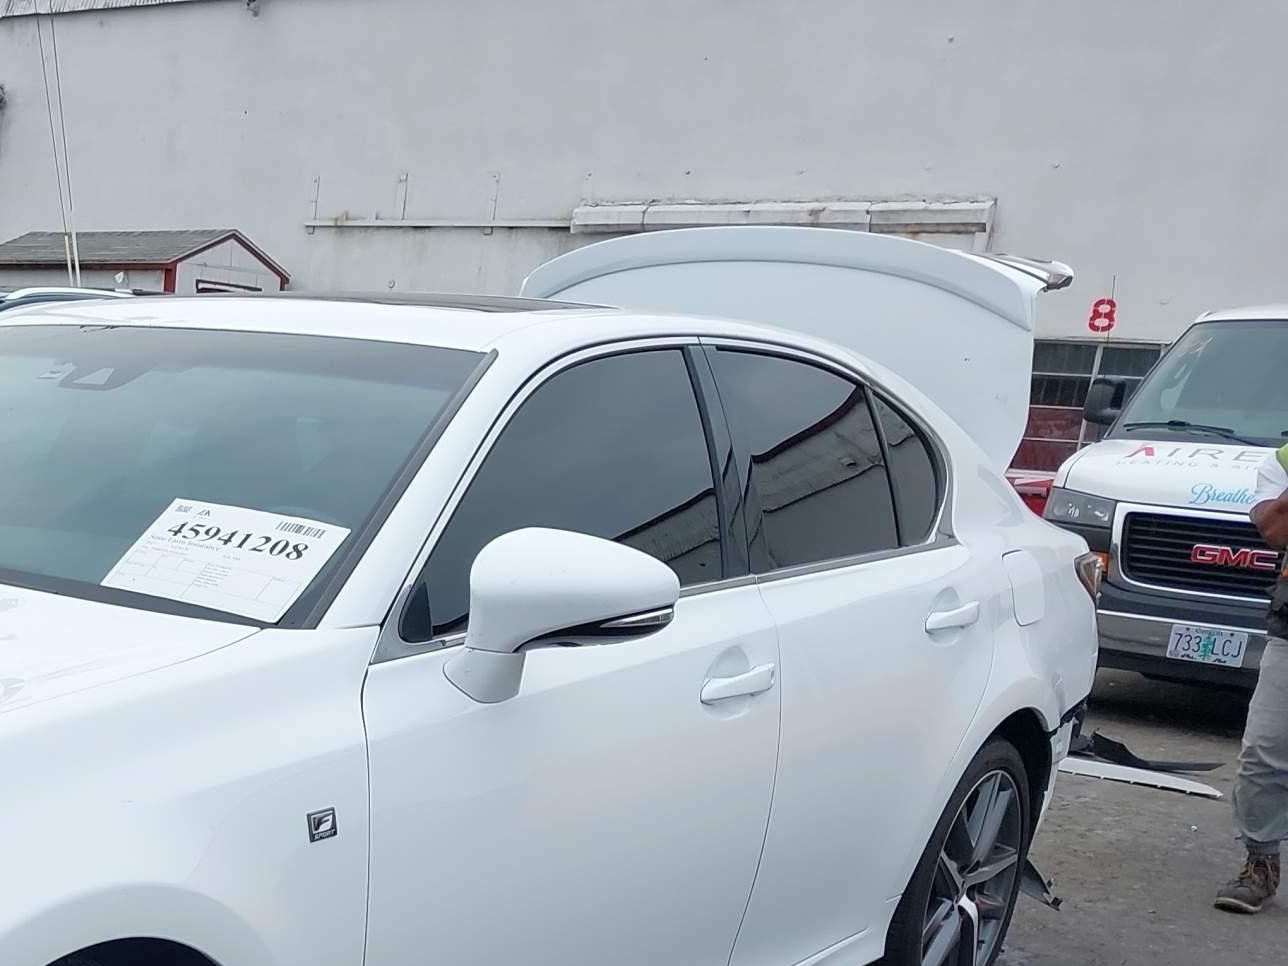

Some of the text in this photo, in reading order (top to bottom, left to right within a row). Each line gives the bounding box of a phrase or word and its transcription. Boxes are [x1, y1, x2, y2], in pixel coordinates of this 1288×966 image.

[1088, 298, 1116, 333] 8
[1188, 483, 1256, 505] Breathe
[167, 521, 309, 561] 45941208
[1191, 543, 1279, 571] GMC
[1174, 632, 1243, 658] 733 LCJ
